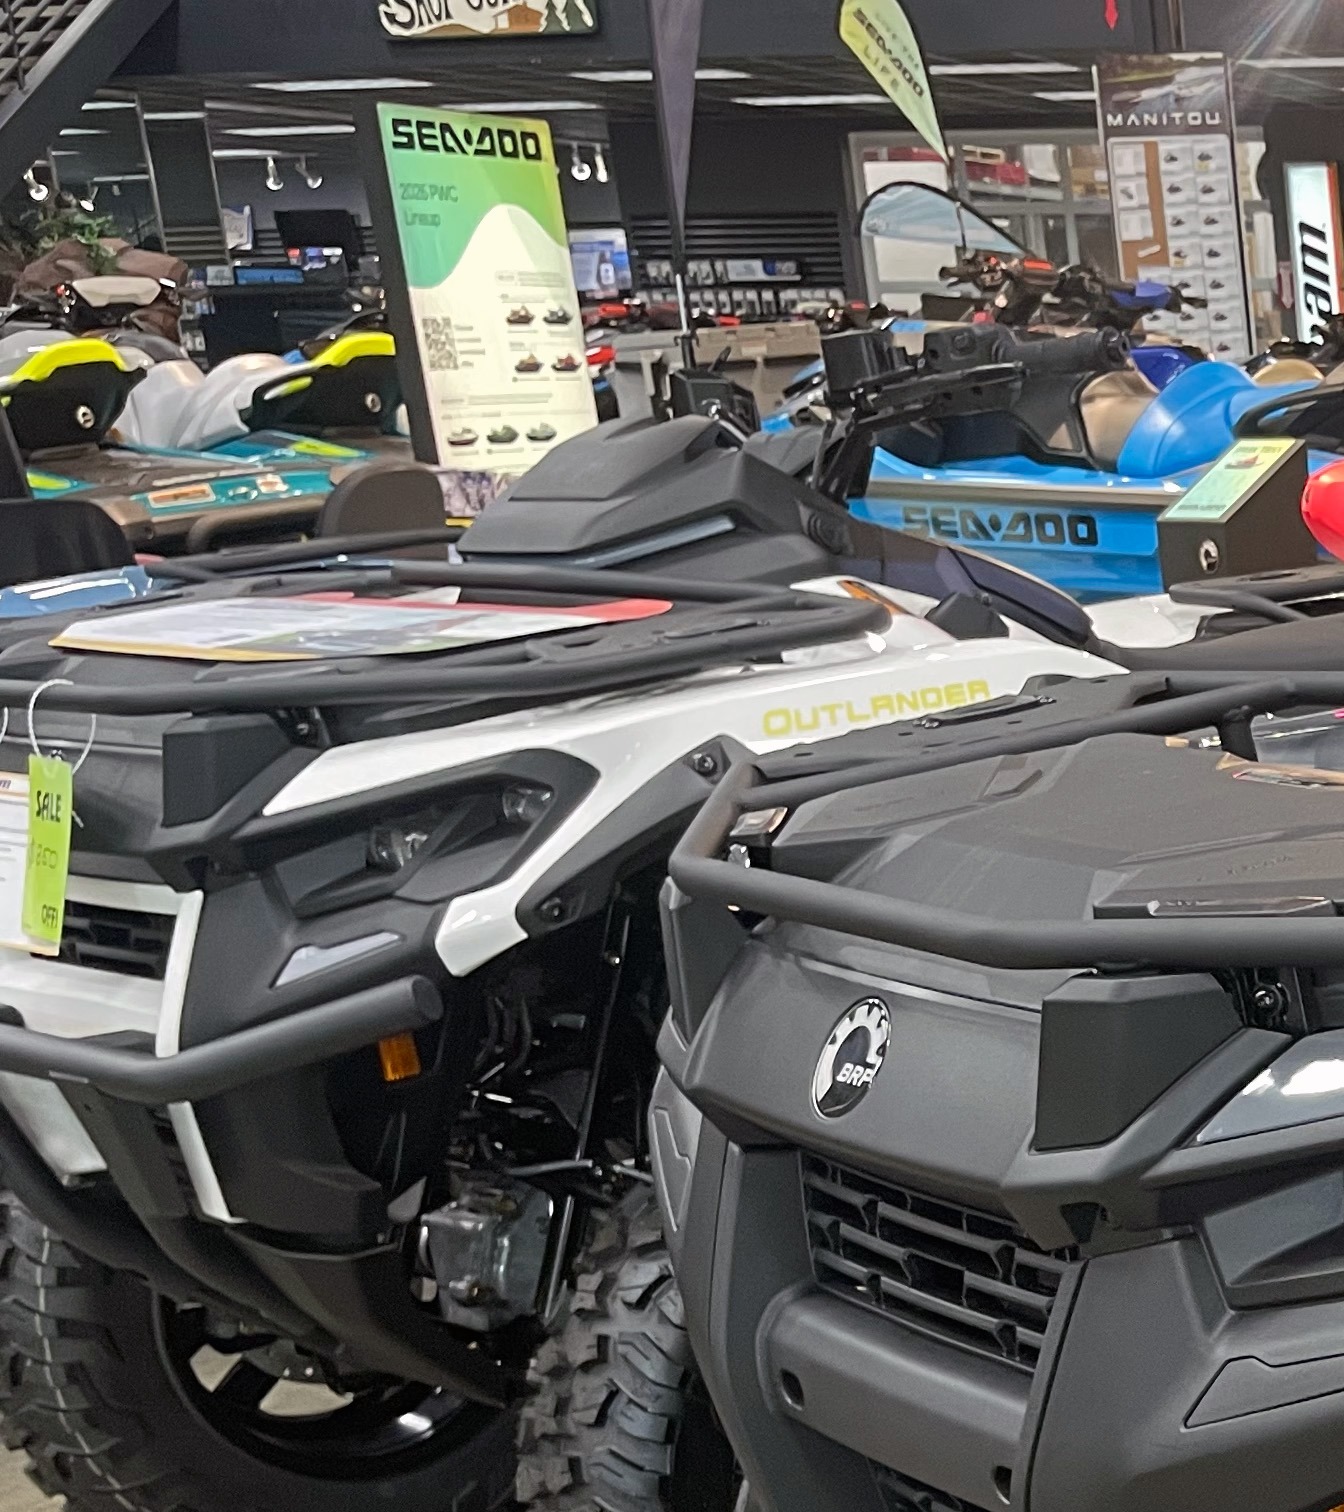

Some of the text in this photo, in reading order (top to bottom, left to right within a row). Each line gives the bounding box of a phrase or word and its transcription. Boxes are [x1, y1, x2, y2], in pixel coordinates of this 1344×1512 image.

[1106, 111, 1221, 127] MANITOU
[762, 679, 992, 737] OUTLANDER
[35, 789, 62, 823] SALE
[835, 1061, 876, 1088] BRP
